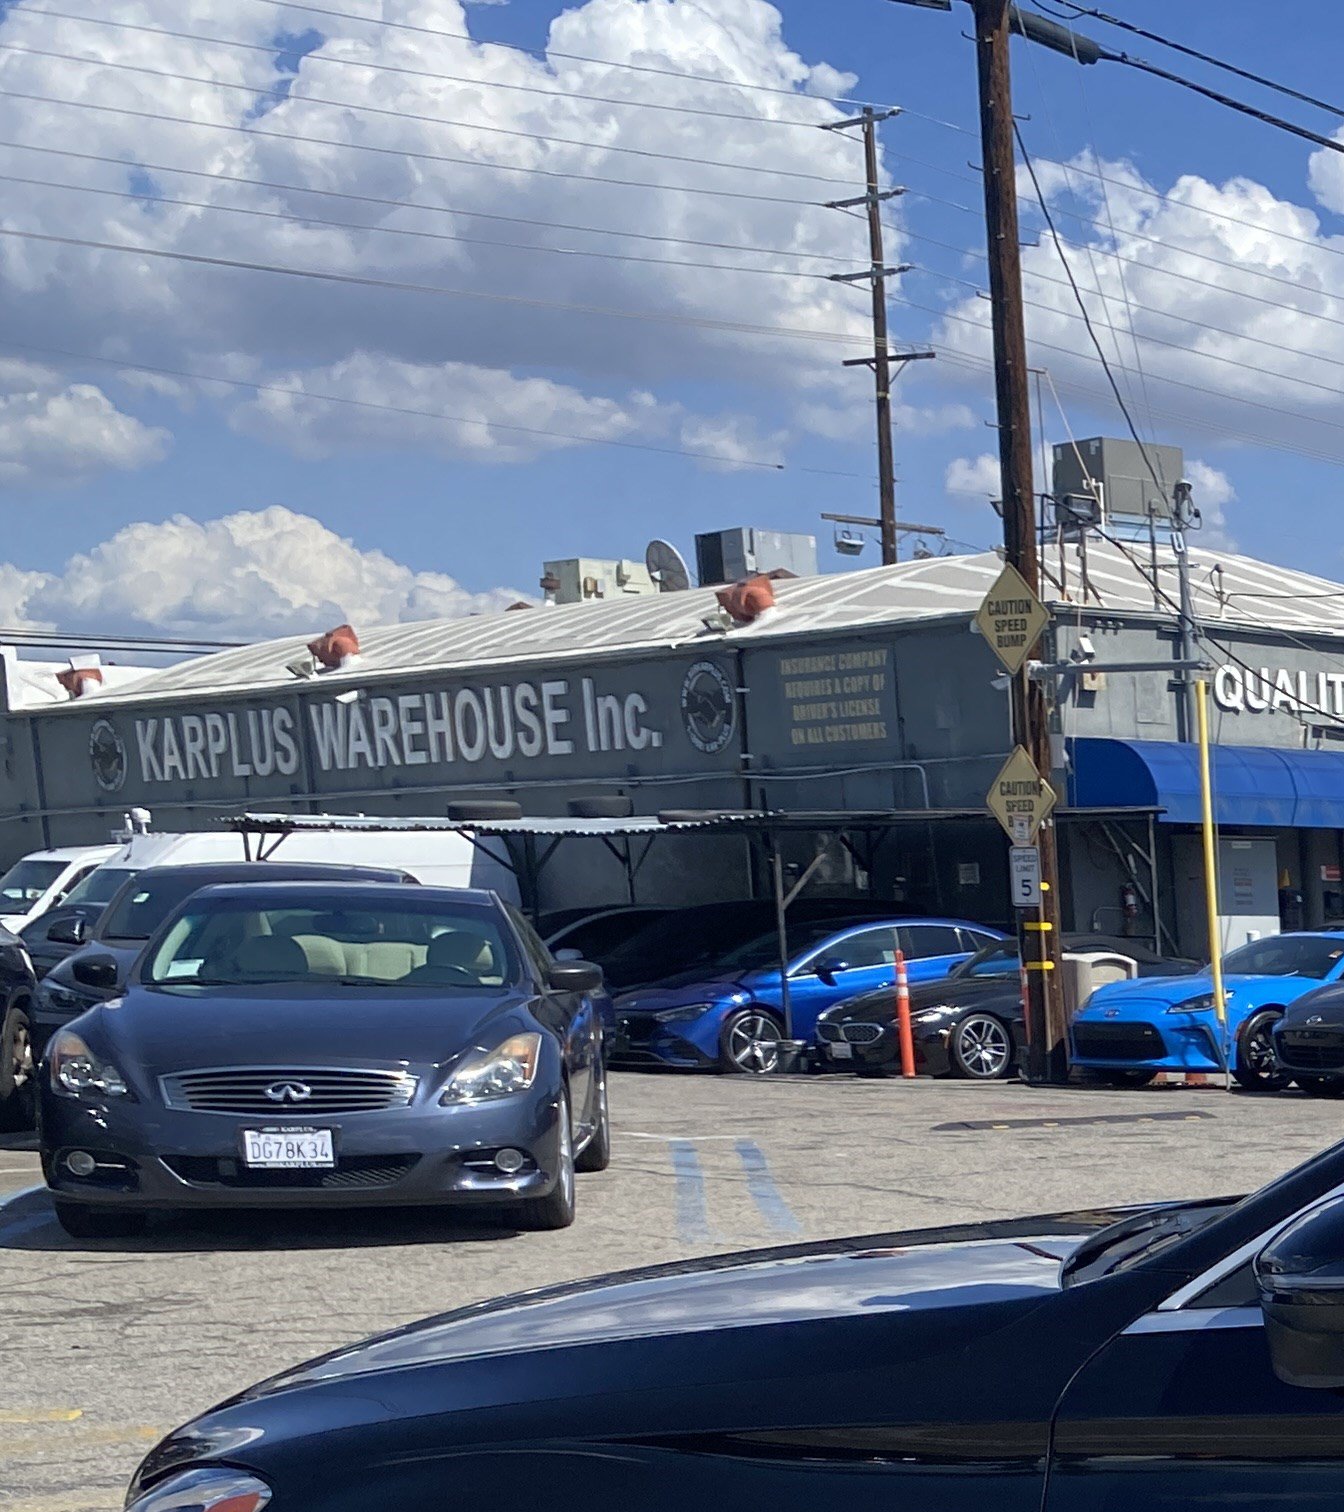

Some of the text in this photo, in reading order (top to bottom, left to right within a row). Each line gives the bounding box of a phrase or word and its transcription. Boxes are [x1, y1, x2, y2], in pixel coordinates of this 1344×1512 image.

[988, 599, 1032, 616] CAUTION
[994, 618, 1027, 632] SPEED
[997, 633, 1026, 648] BUMP
[781, 649, 887, 675] INSURANCE COMPANY
[843, 675, 870, 694] COPY
[872, 673, 885, 691] OF
[840, 698, 880, 718] LICENSE
[134, 706, 298, 782] KARPLUS
[309, 680, 574, 771] WAREHOUSE
[581, 677, 663, 752] Inc.
[791, 727, 806, 745] ON
[825, 722, 887, 742] CUSTOMERS
[1000, 780, 1040, 796] CAUTION
[1006, 800, 1034, 812] SPEED
[1008, 815, 1034, 827] BP
[1013, 854, 1037, 863] SPEED
[1015, 864, 1035, 873] LIMIT
[1021, 879, 1032, 897] 5
[251, 1141, 329, 1160] DG78K34
